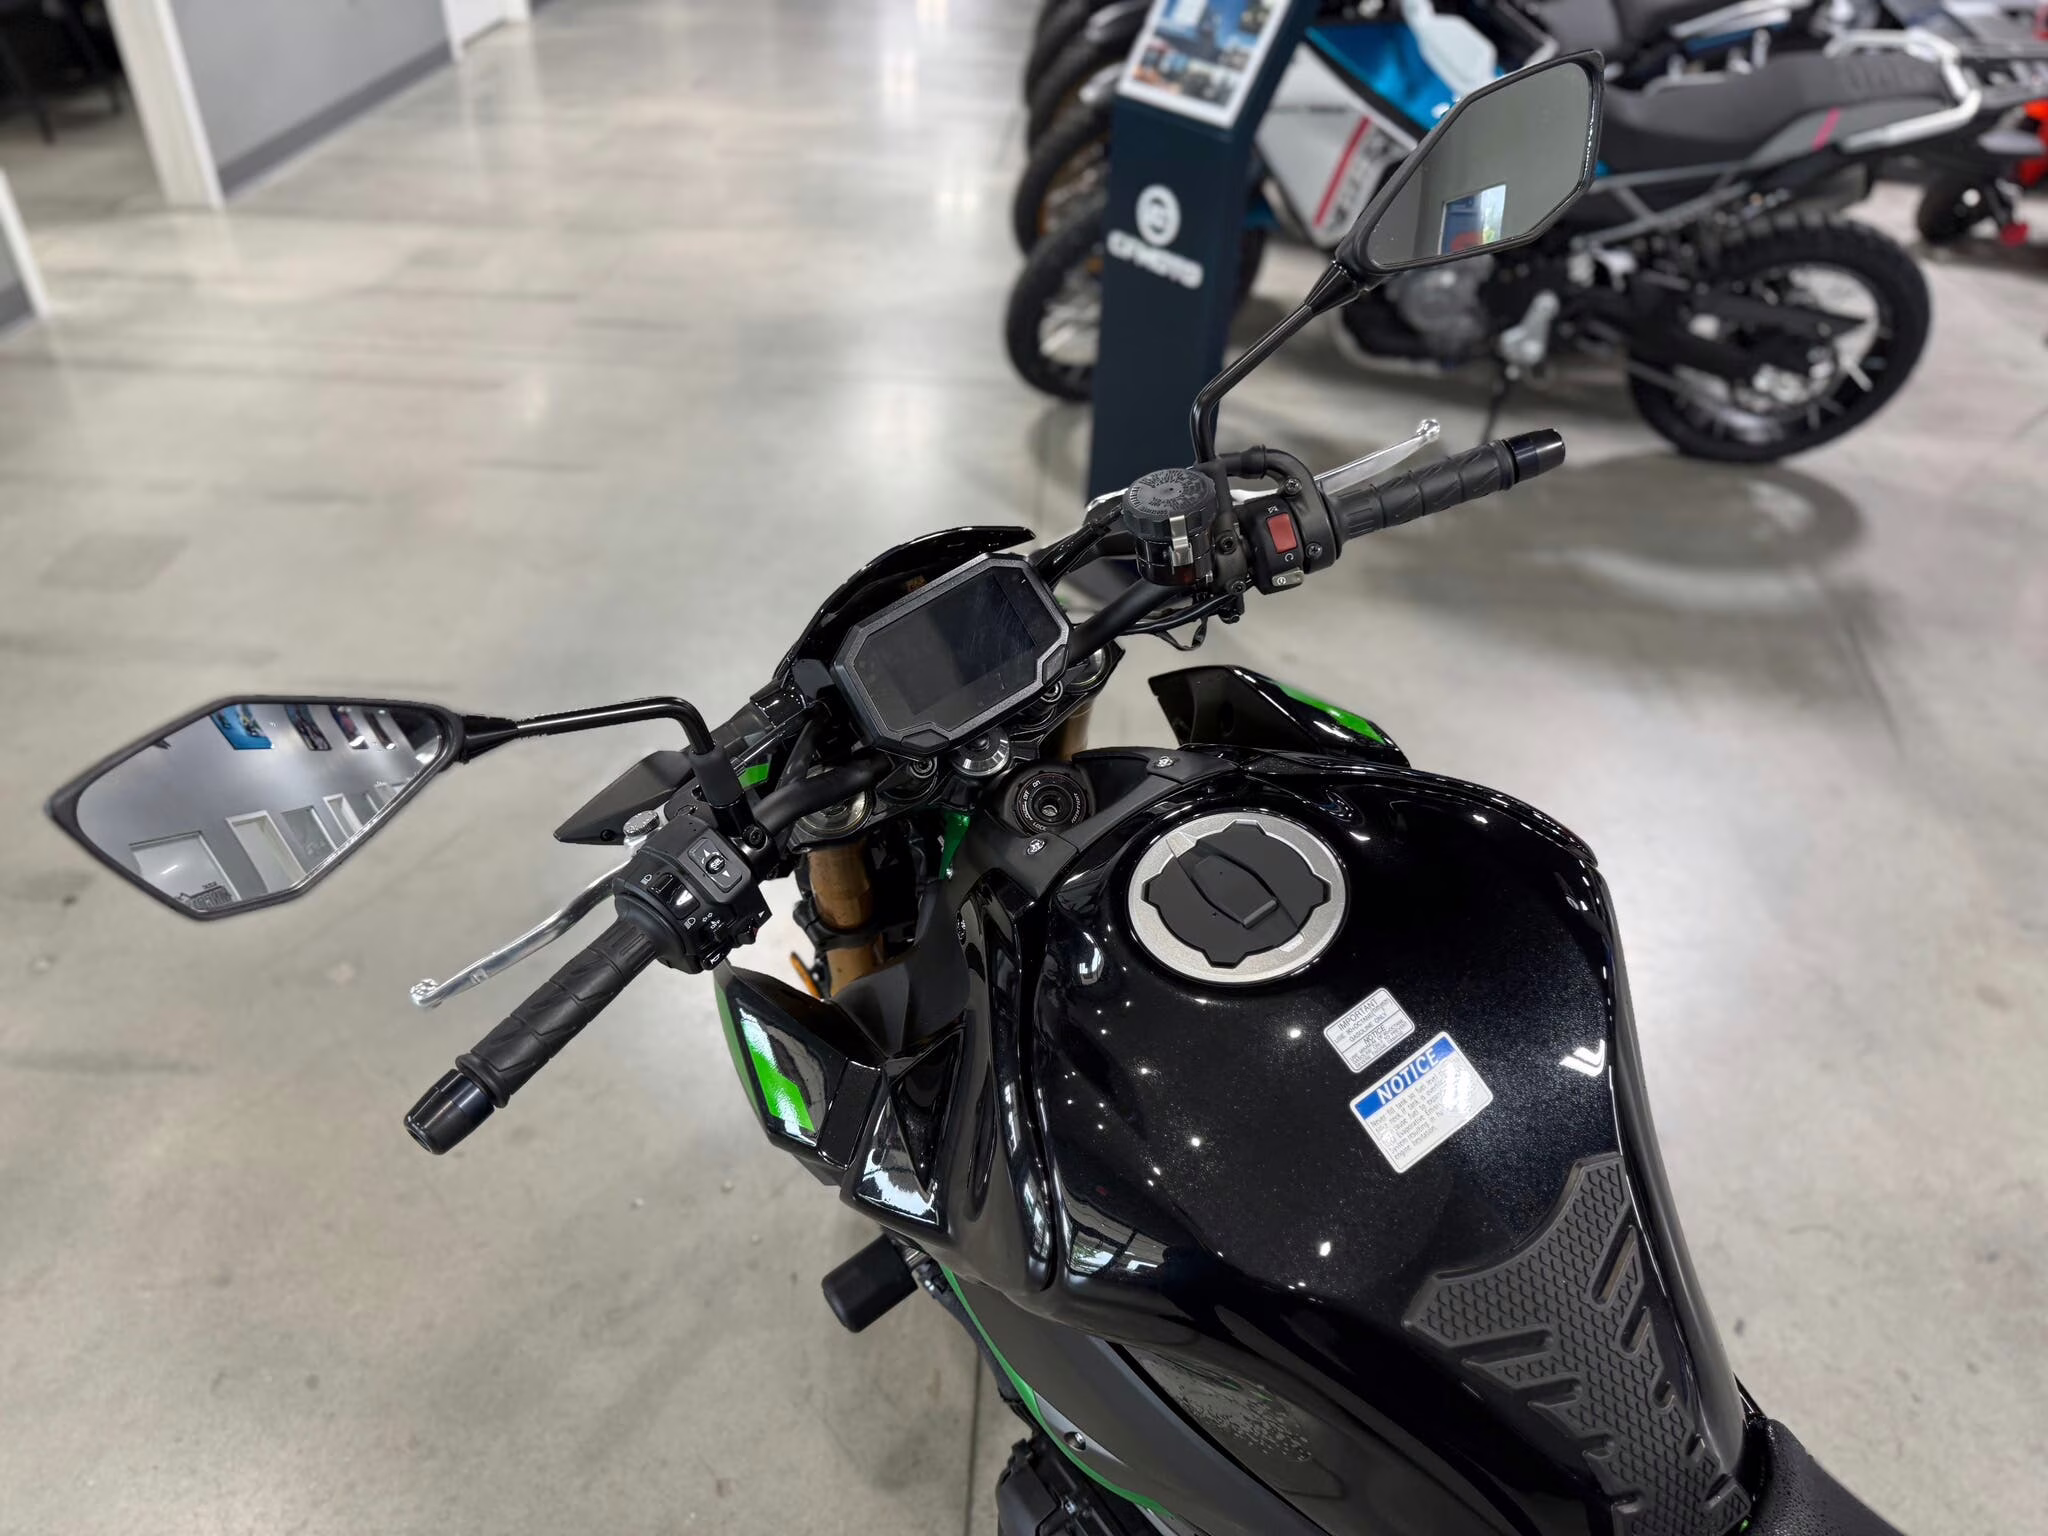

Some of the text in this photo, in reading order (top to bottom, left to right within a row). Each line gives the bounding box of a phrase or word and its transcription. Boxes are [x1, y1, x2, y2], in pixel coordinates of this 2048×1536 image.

[1337, 997, 1378, 1031] IMPORTANT
[1363, 1024, 1386, 1044] NOTICE
[1375, 1047, 1438, 1105] NOTICE
